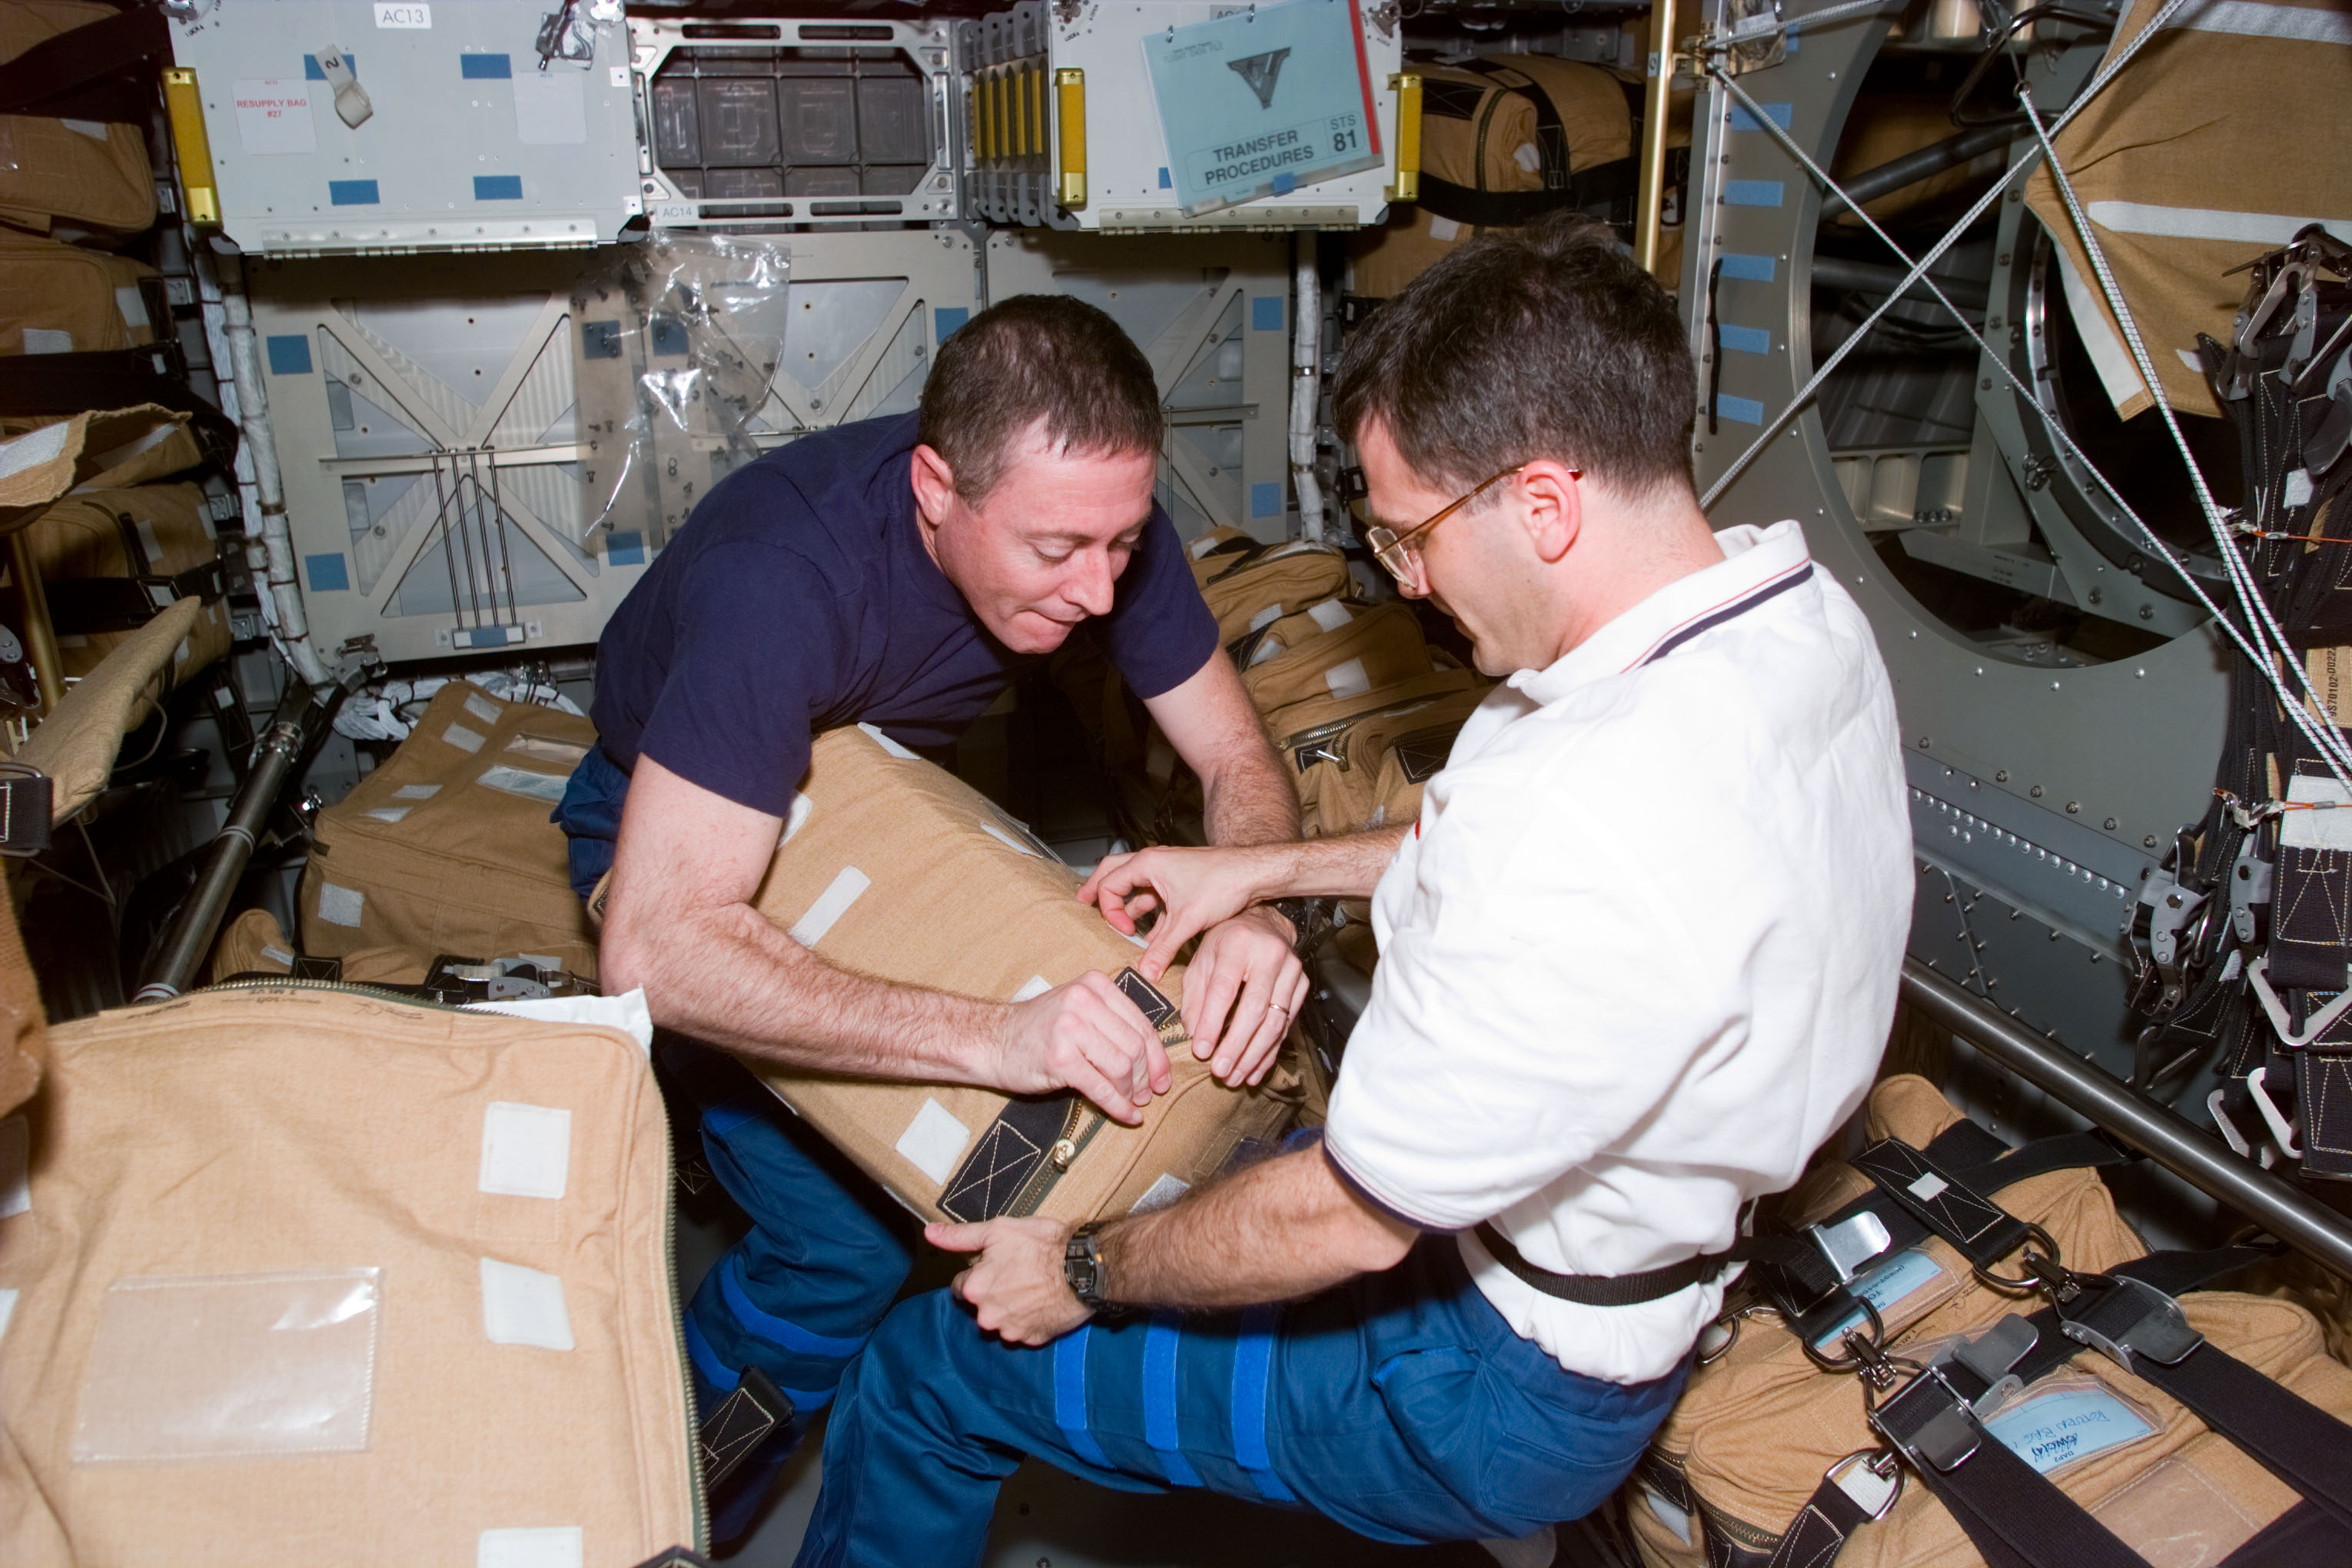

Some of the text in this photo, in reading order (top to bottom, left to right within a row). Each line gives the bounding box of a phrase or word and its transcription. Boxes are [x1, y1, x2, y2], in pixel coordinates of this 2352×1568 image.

[382, 9, 424, 24] AC13
[236, 98, 307, 108] RESUPPLY BAG
[1330, 115, 1357, 130] STS
[1213, 130, 1299, 162] TRANSFER
[1334, 129, 1357, 152] 81
[1204, 145, 1314, 185] PROCEDURES
[663, 207, 692, 218] AC14
[2023, 1427, 2057, 1444] BAG
